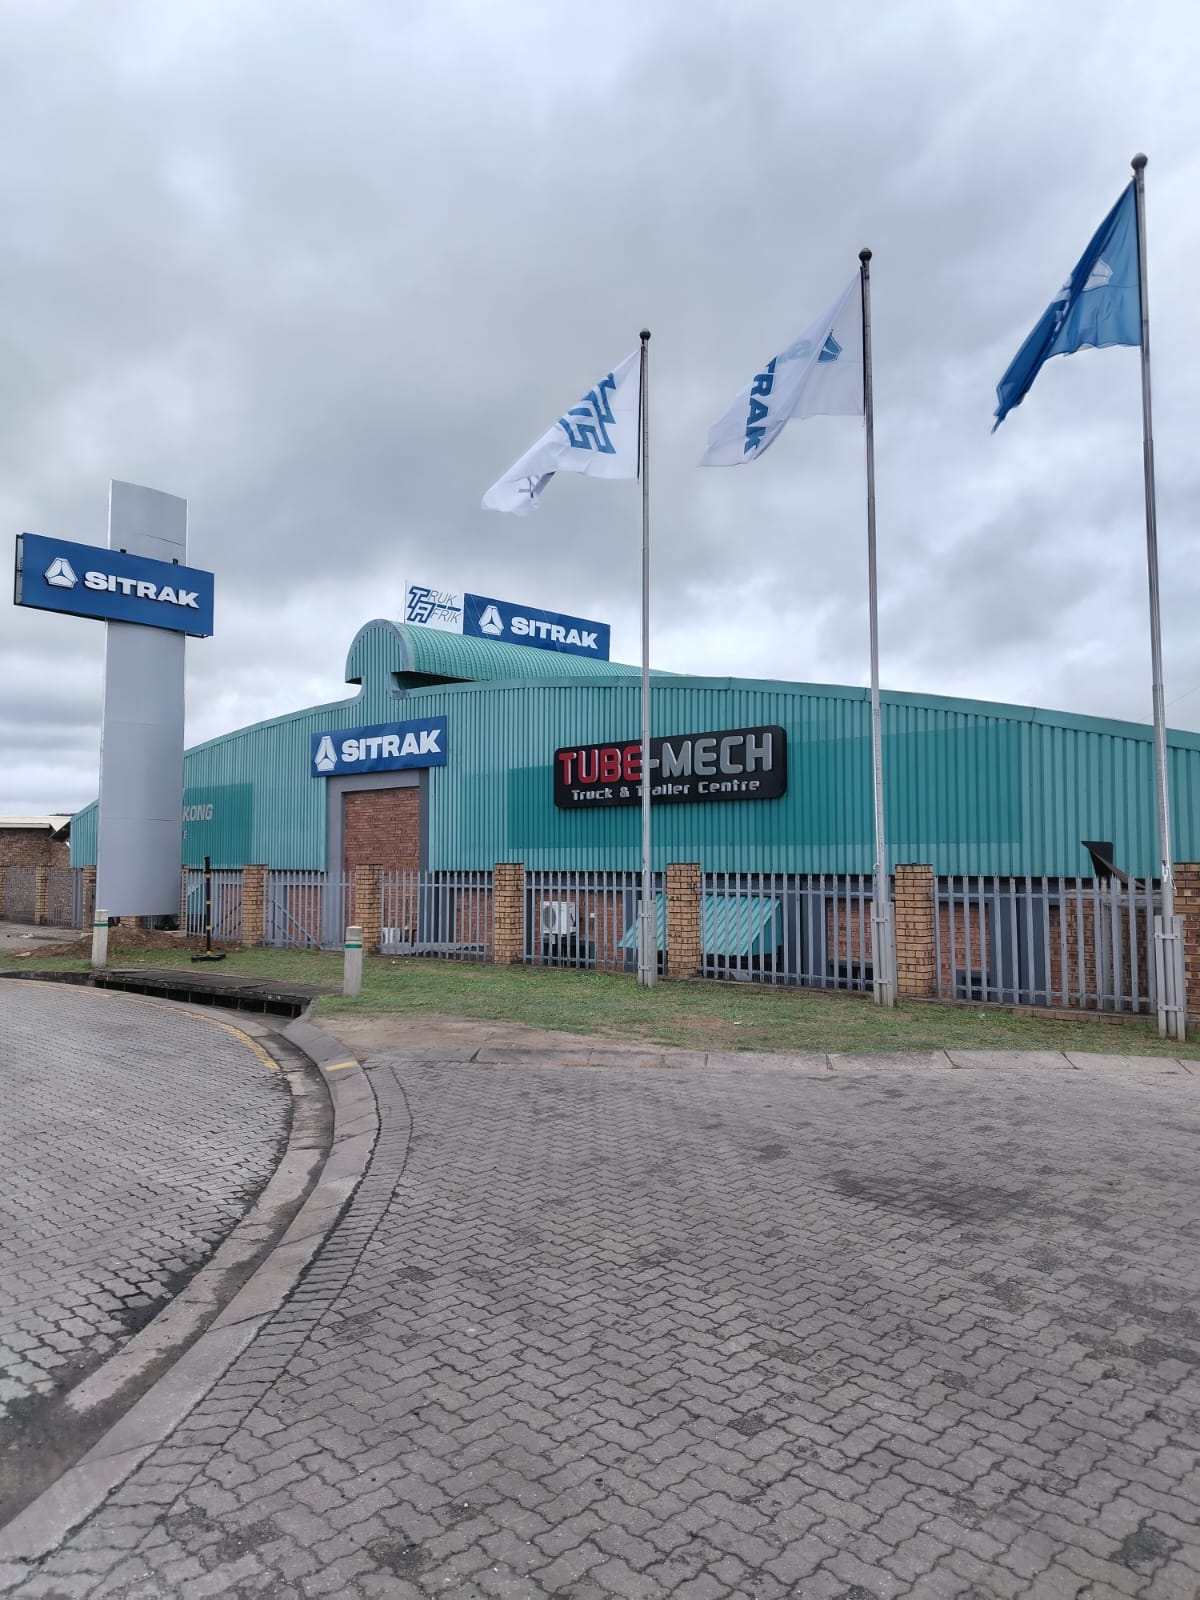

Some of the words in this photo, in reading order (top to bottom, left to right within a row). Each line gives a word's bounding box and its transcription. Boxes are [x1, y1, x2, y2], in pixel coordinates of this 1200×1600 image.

[84, 571, 200, 609] SITRAK
[510, 616, 599, 650] SITRAK
[341, 729, 442, 763] SITRAK
[558, 732, 773, 786] TUBE-MECH
[571, 787, 613, 801] Truck
[619, 786, 630, 798] &
[635, 783, 690, 797] Tailer
[697, 779, 760, 794] Centre
